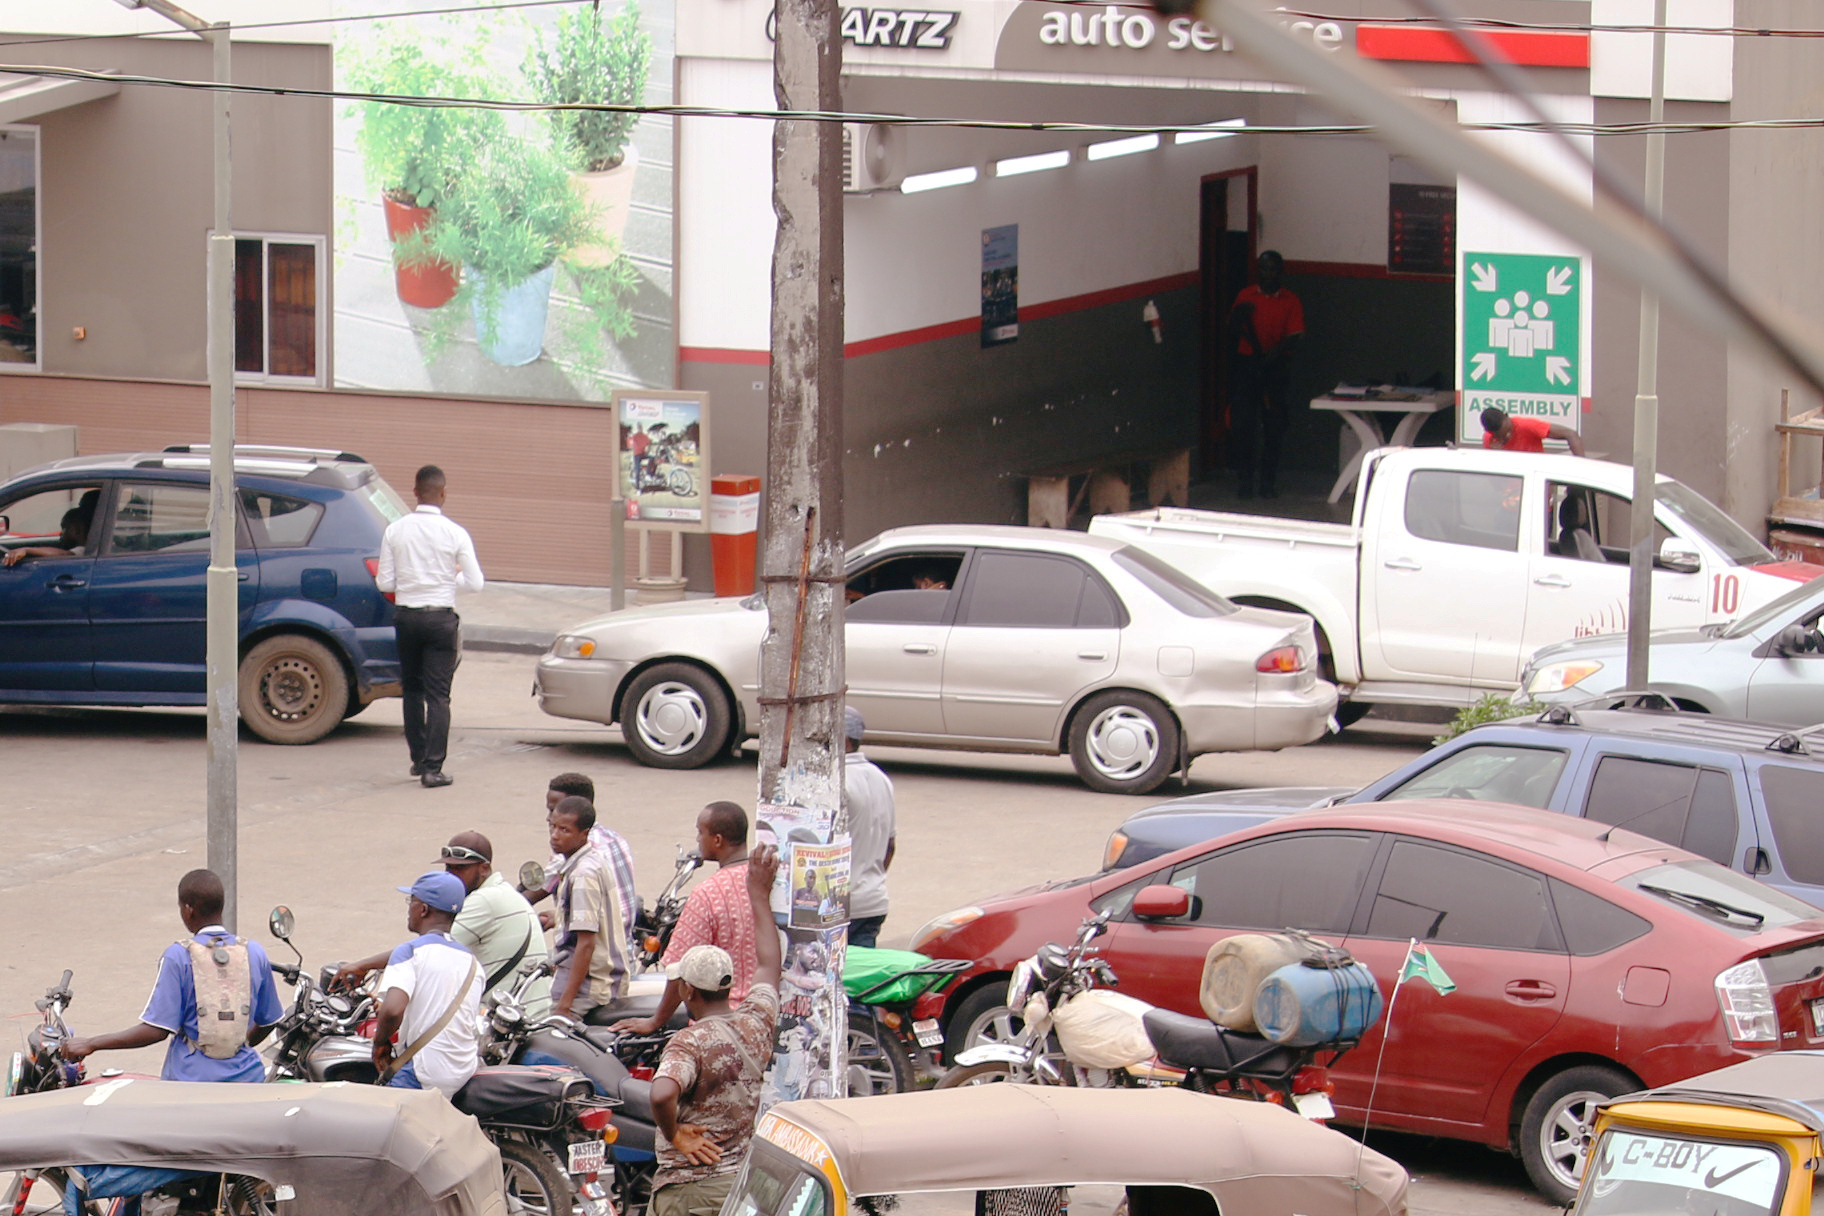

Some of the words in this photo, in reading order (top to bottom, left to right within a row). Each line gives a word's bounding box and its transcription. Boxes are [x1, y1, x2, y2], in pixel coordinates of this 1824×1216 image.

[1041, 6, 1154, 49] auto
[1469, 396, 1573, 419] ASSEMBLY
[1711, 573, 1740, 615] 10
[1622, 1138, 1718, 1174] C-BOY
